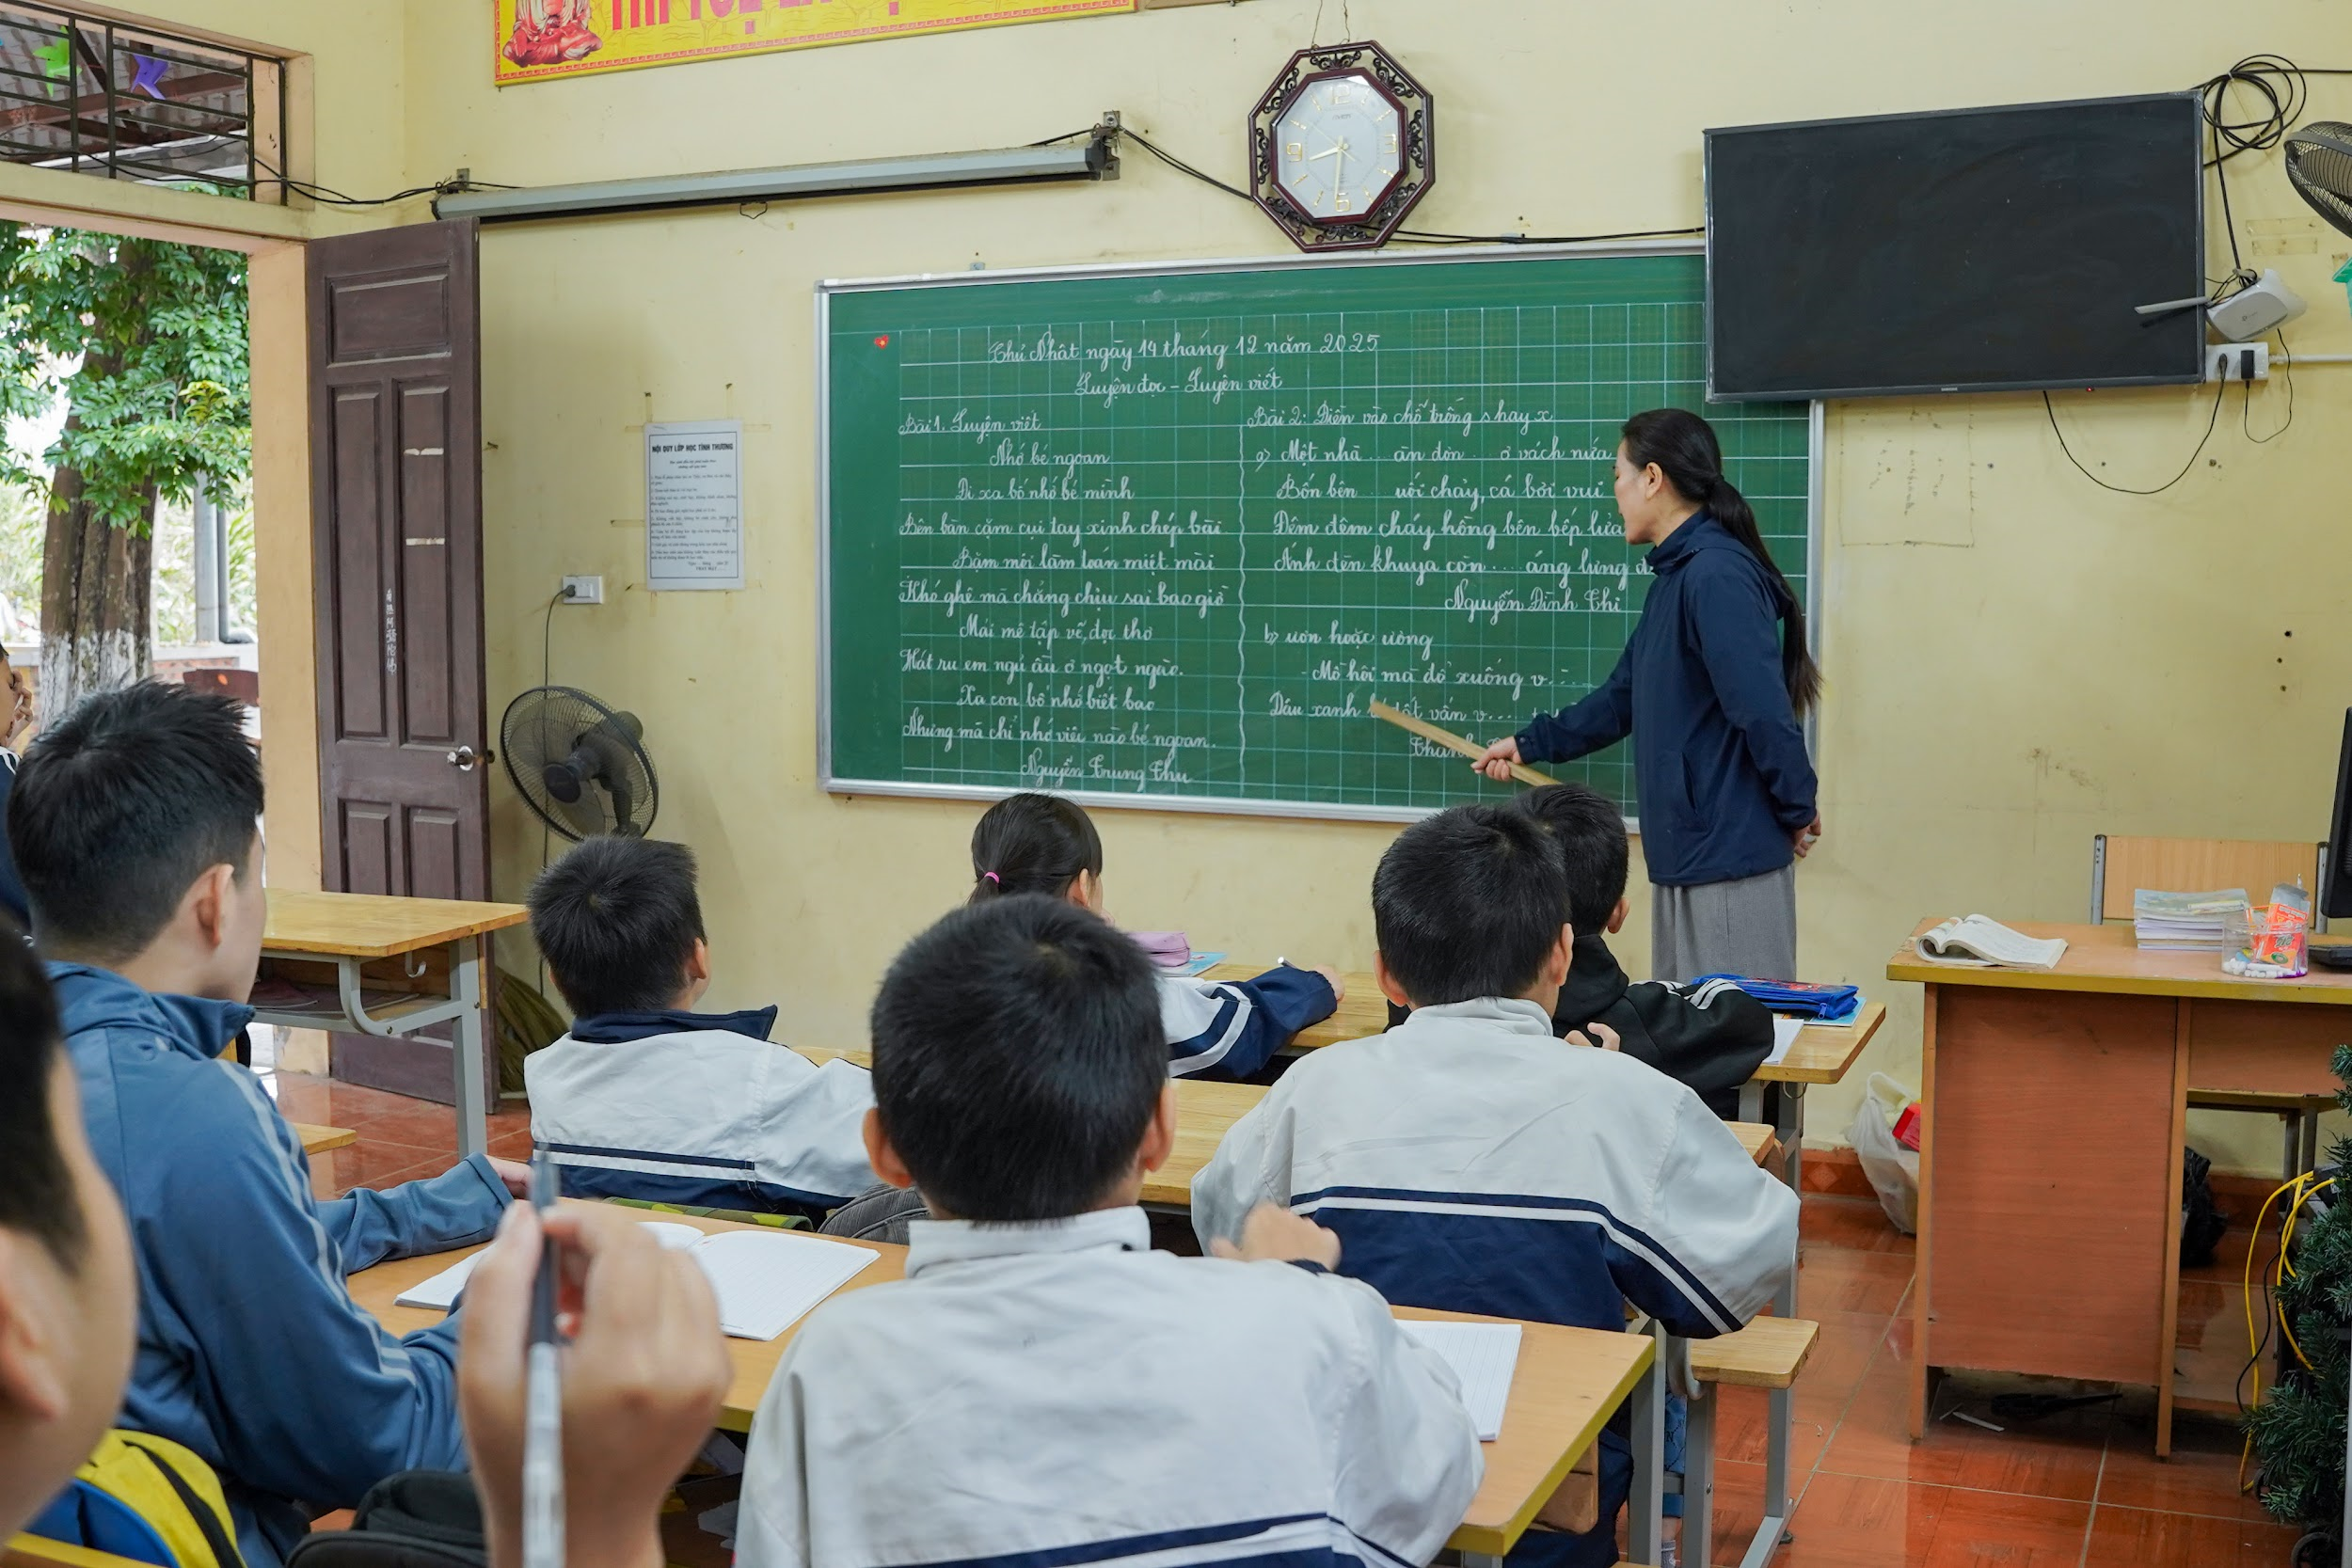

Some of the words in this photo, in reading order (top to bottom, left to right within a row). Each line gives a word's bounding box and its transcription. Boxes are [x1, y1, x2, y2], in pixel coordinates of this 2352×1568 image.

[1330, 85, 1351, 104] 12
[1286, 142, 1302, 162] 9
[1384, 134, 1397, 154] 3
[1086, 340, 1133, 372] ngày
[1137, 340, 1157, 356] 14
[1163, 329, 1228, 371] tháng
[1235, 335, 1257, 356] 12
[1264, 335, 1311, 353] năm
[1320, 333, 1380, 354] 2025
[1074, 372, 1136, 408] Luyện
[1136, 373, 1166, 397] đọc
[1184, 367, 1242, 404] Luyện
[1248, 368, 1282, 389] viết
[898, 413, 930, 435] Bài
[950, 408, 1006, 444] Luyện
[1010, 409, 1041, 431] viết
[1247, 405, 1284, 428] Bài
[1363, 406, 1388, 424] vào
[1429, 397, 1472, 436] trống
[1494, 399, 1530, 436] hay
[1030, 442, 1049, 464] bé
[1053, 453, 1110, 480] ngoan
[1281, 438, 1318, 467] Một
[1518, 436, 1565, 461] vách
[956, 478, 975, 500] Đi
[978, 488, 1004, 499] xa
[1008, 478, 1029, 499] bố
[1061, 477, 1079, 500] bé
[1083, 476, 1136, 499] mình
[1277, 473, 1323, 499] Bốn
[1327, 472, 1358, 499] bên
[1489, 474, 1516, 499] cá
[1563, 482, 1604, 499] vui
[898, 513, 934, 535] Bên
[940, 512, 970, 534] bàn
[975, 518, 1012, 539] cặm
[1018, 520, 1045, 540] cụi
[1050, 516, 1081, 547] tay
[1086, 511, 1136, 534] xinh
[1139, 510, 1184, 547] chép
[1273, 510, 1319, 536] Đêm
[1325, 514, 1373, 536] đêm
[1378, 509, 1435, 551] cháy
[1440, 509, 1496, 550] hồng
[1502, 510, 1541, 535] bên
[1548, 507, 1582, 546] bếp
[1039, 543, 1075, 568] làm
[1274, 542, 1320, 571] Ánh
[1326, 551, 1365, 573] đèn
[1371, 545, 1439, 586] khuya
[944, 579, 975, 617] ghê
[979, 588, 1008, 604] mà
[1074, 581, 1118, 612] chịu
[1121, 589, 1152, 605] sai
[1157, 581, 1192, 605] bao
[1195, 585, 1229, 619] giờ
[1444, 578, 1524, 626] Nguyễn
[1528, 586, 1578, 611] Đình
[1583, 586, 1622, 612] Thi
[1001, 623, 1024, 639] mê
[1029, 620, 1059, 650] tập
[1089, 618, 1116, 644] đọc
[1328, 620, 1375, 649] hoặc
[899, 648, 934, 672] Hát
[936, 658, 959, 672] ru
[963, 659, 988, 673] em
[993, 655, 1025, 685] ngủ
[1081, 654, 1127, 689] ngọt
[1346, 658, 1375, 682] hôi
[1455, 658, 1523, 701] xuống
[957, 684, 986, 706] Xa
[991, 696, 1020, 706] con
[1025, 684, 1050, 707] bố
[1087, 684, 1118, 710] biết
[1122, 687, 1154, 711] bao
[1308, 692, 1361, 717] xanh
[1092, 726, 1128, 744] nào
[1129, 721, 1150, 746] bé
[1021, 748, 1084, 787] Nguyễn
[1089, 754, 1146, 792] Trung
[1148, 752, 1193, 784] Thu
